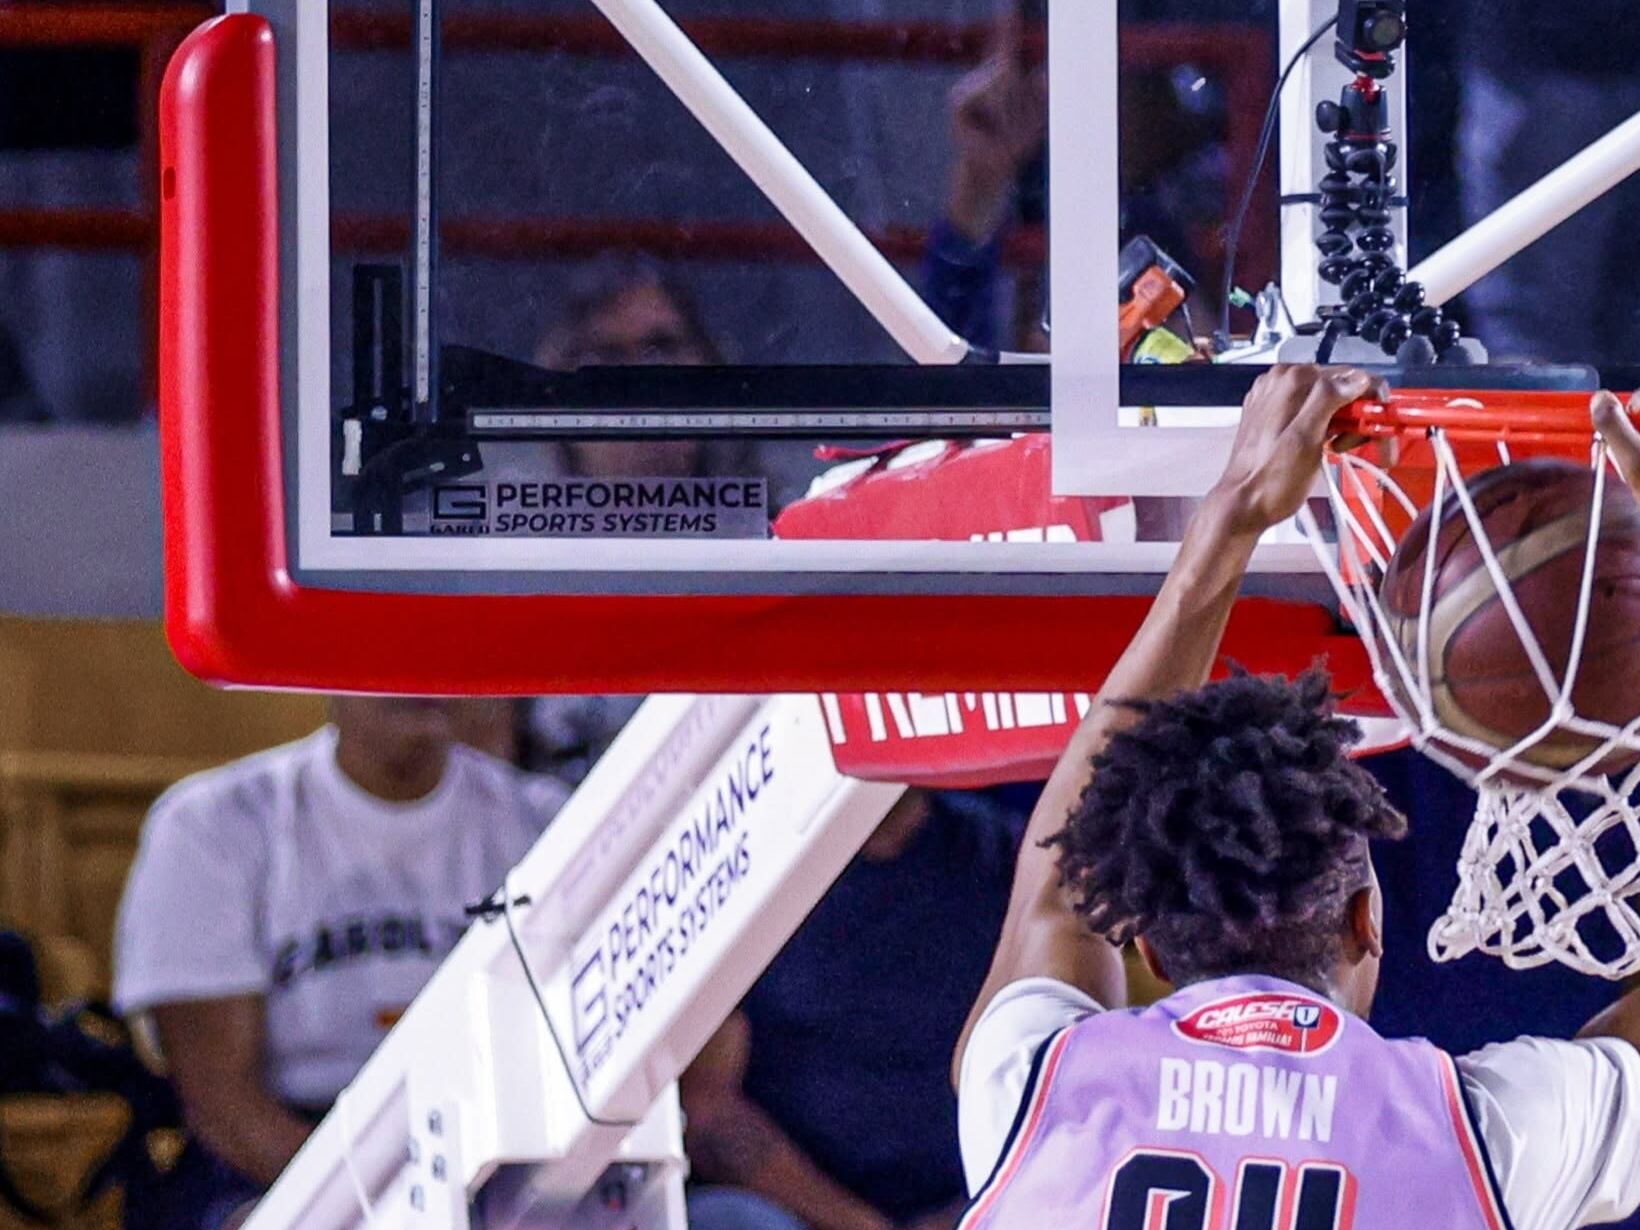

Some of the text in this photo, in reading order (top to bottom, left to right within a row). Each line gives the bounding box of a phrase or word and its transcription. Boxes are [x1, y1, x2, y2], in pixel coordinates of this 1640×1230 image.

[495, 513, 717, 533] SPORTS SYSTEMS
[496, 483, 763, 509] PERFORMANCE
[608, 724, 775, 980] PERFORMANCE
[614, 928, 676, 1039] SPORTS
[1156, 1055, 1338, 1142] BROWN
